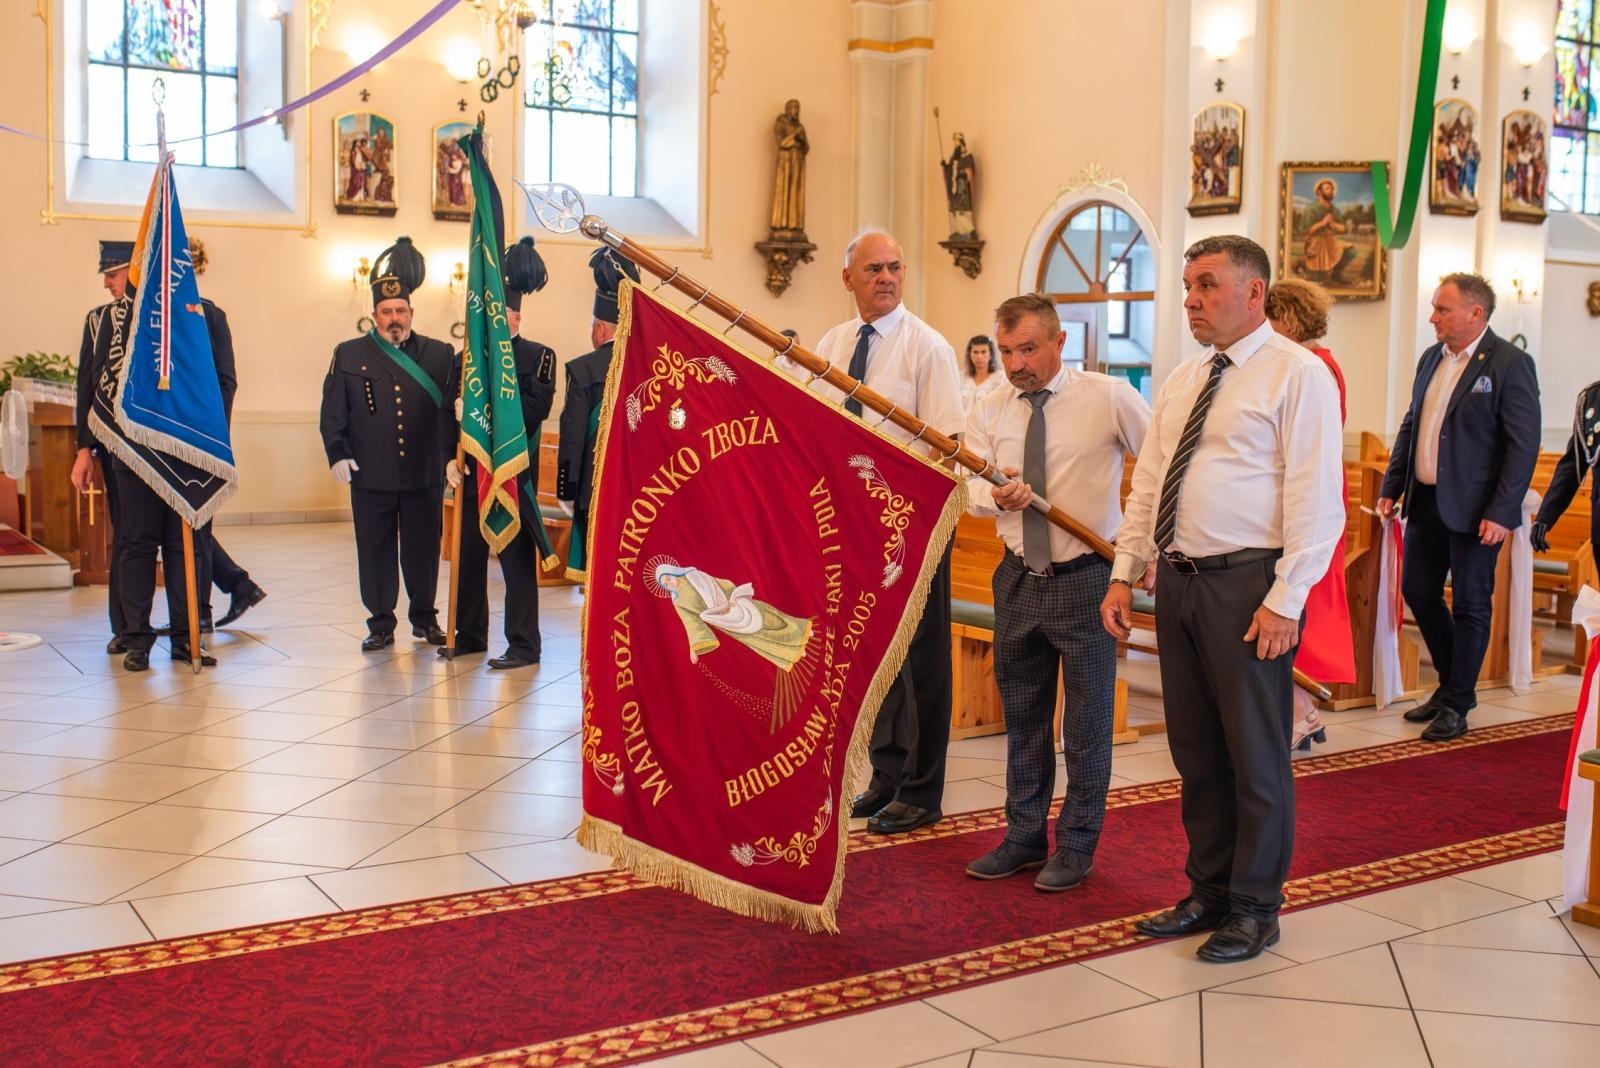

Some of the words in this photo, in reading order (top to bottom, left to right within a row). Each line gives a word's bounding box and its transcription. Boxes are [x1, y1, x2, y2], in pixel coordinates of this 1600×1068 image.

[463, 340, 484, 398] RACI
[469, 407, 493, 435] ZAW
[701, 409, 780, 460] ZBOŻA
[614, 446, 701, 594] PATRONKO
[809, 475, 839, 539] POLA
[822, 544, 841, 556] I
[825, 563, 844, 617] ŁĄKI
[611, 606, 634, 692] BOŻA
[820, 625, 836, 702] NASZE
[822, 661, 851, 779] ZAWADA
[842, 590, 876, 652] 2005
[621, 701, 673, 807] MATKO
[725, 704, 828, 808] BŁOGOSŁAW
